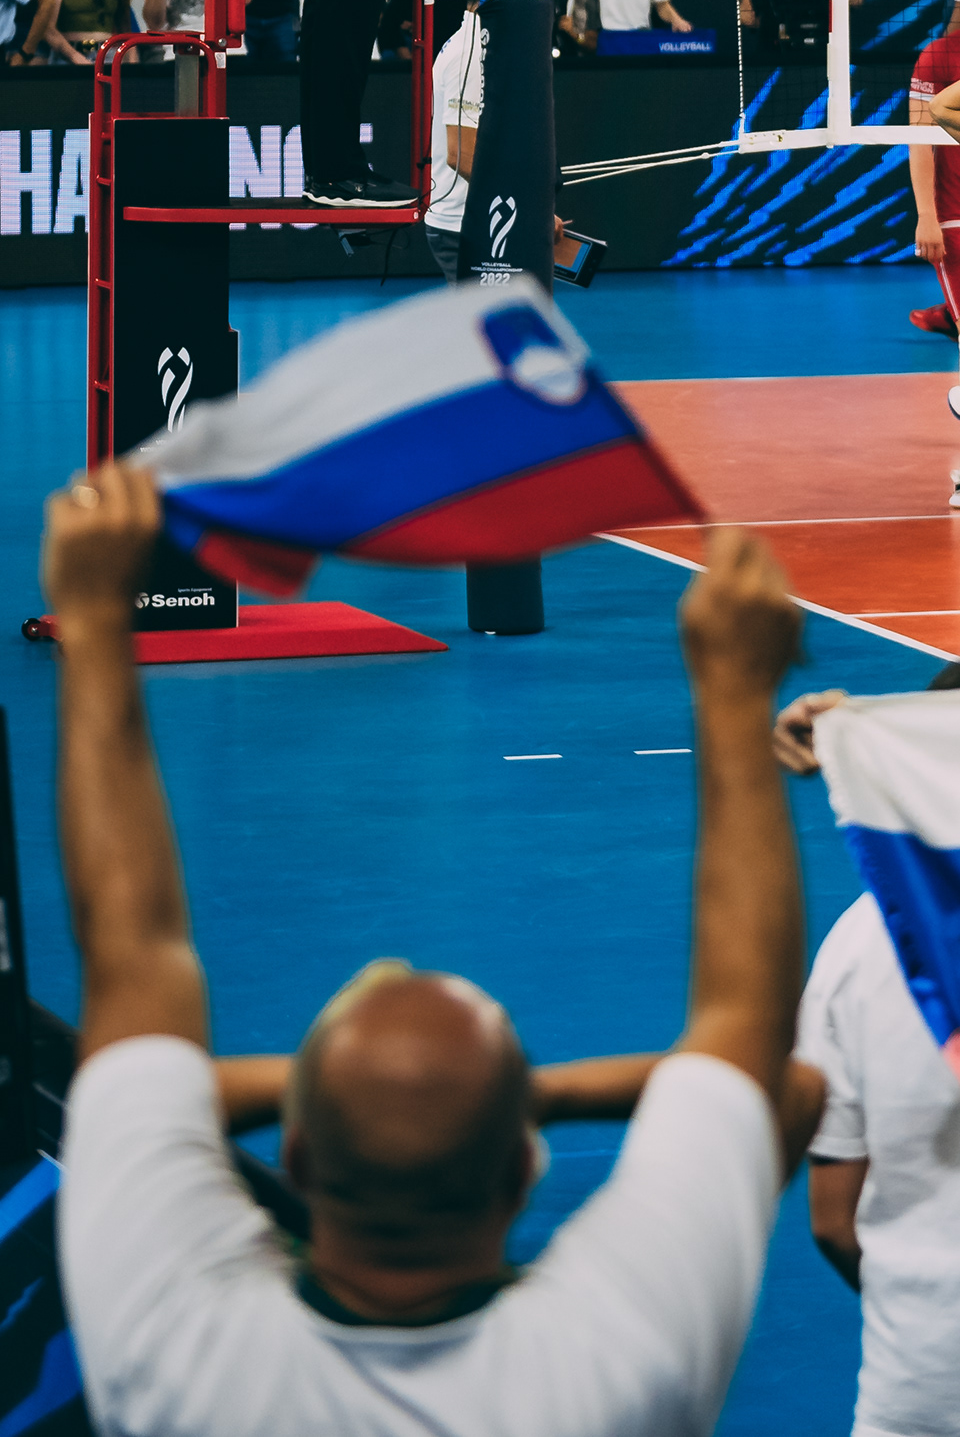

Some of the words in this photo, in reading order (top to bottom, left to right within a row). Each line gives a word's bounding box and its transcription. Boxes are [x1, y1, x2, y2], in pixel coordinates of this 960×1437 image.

[659, 41, 711, 52] VOLLEYBALL
[480, 272, 511, 286] 2022
[152, 592, 215, 607] Senoh
